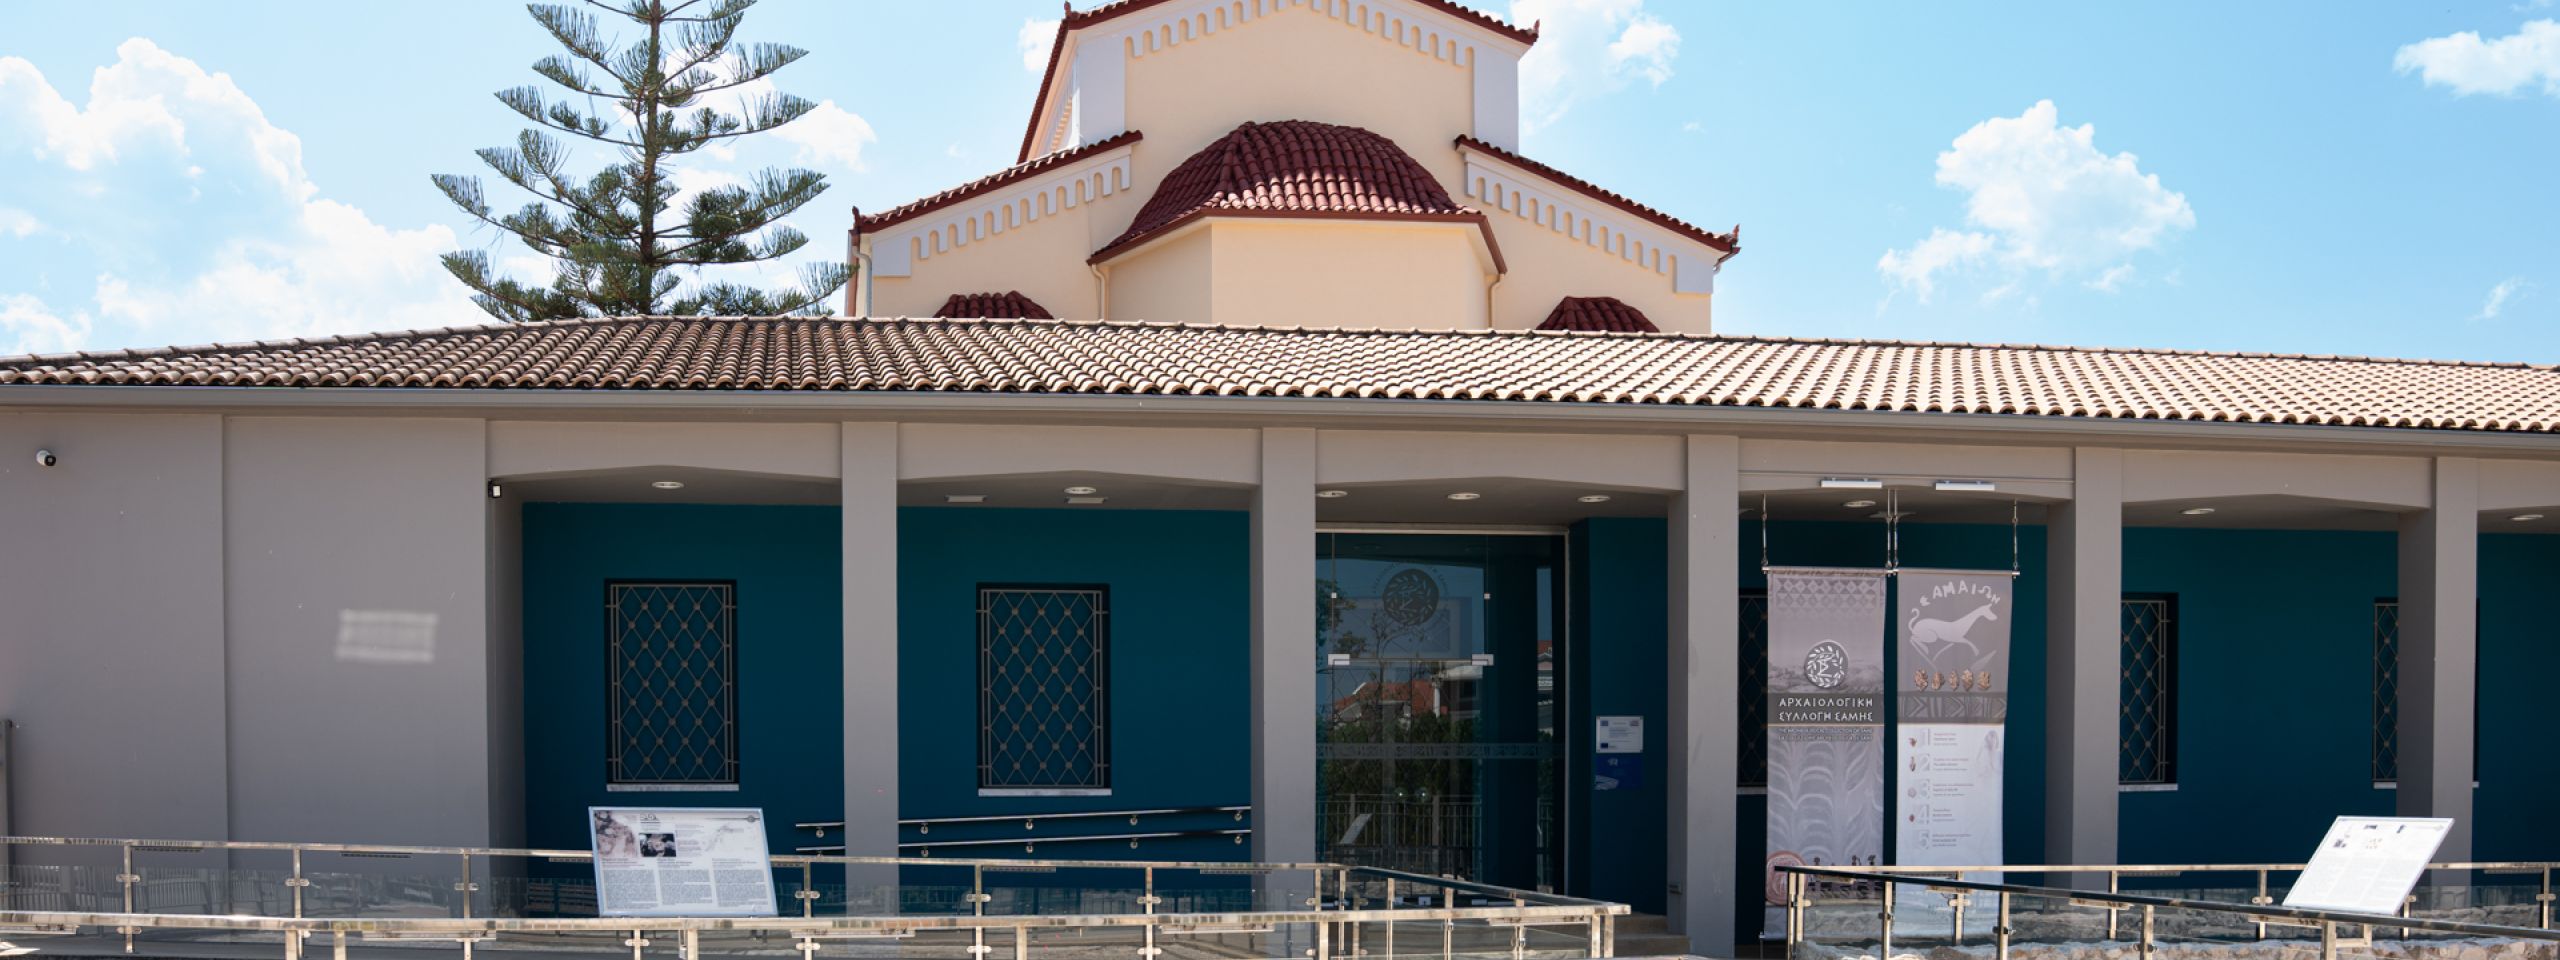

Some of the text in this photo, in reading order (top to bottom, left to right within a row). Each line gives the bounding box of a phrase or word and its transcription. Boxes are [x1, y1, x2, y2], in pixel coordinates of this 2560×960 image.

[1778, 697, 1873, 708] ΑΡΧΑΙΟΛΟΓΙΚΗ
[1778, 711, 1873, 722] ΣΥΛΛΟΓΗ ΣΑΜΗΣ
